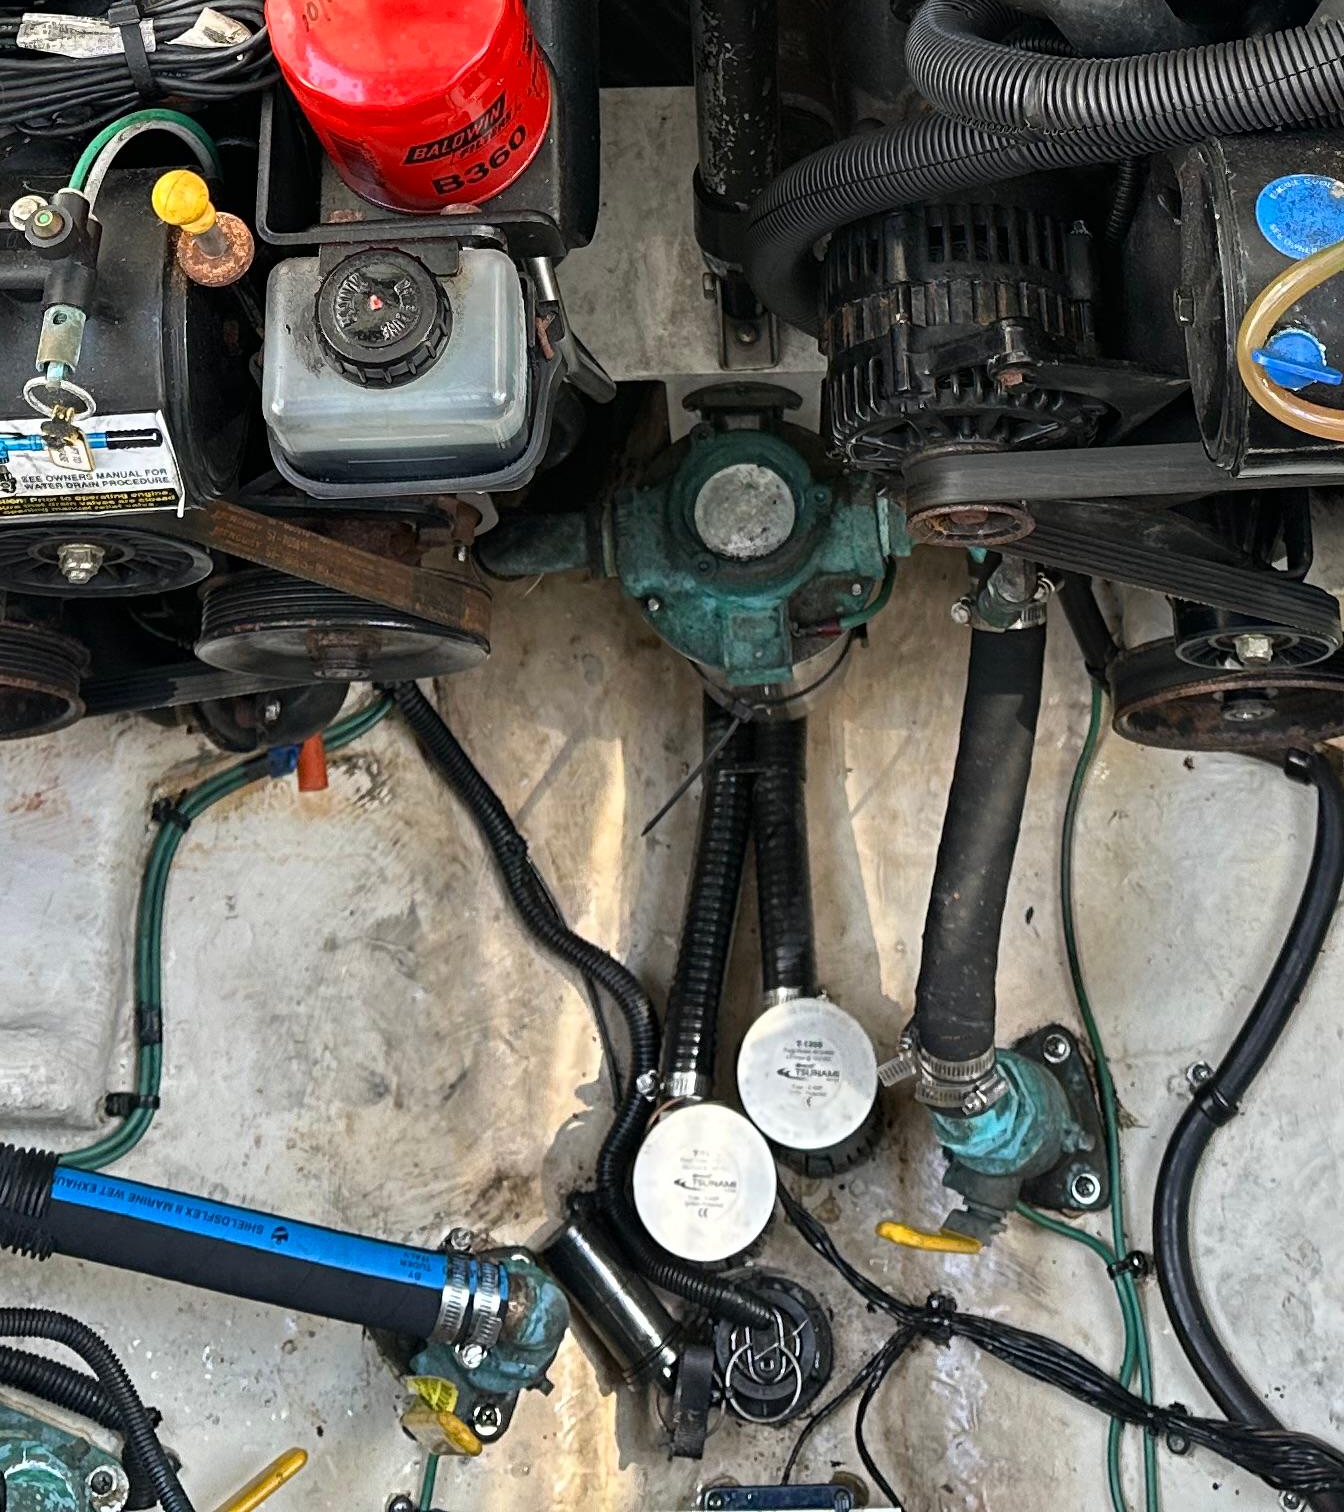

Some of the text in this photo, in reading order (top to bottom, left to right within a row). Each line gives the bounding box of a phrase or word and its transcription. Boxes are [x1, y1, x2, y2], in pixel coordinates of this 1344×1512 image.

[413, 100, 502, 161] BALDWIN
[432, 124, 527, 195] B360
[21, 469, 168, 483] SEE OWNERS MANUAL FOR
[24, 476, 170, 490] WATER DRAIN PROCEDURE
[74, 492, 129, 501] operating
[53, 1174, 97, 1193] EXHAU
